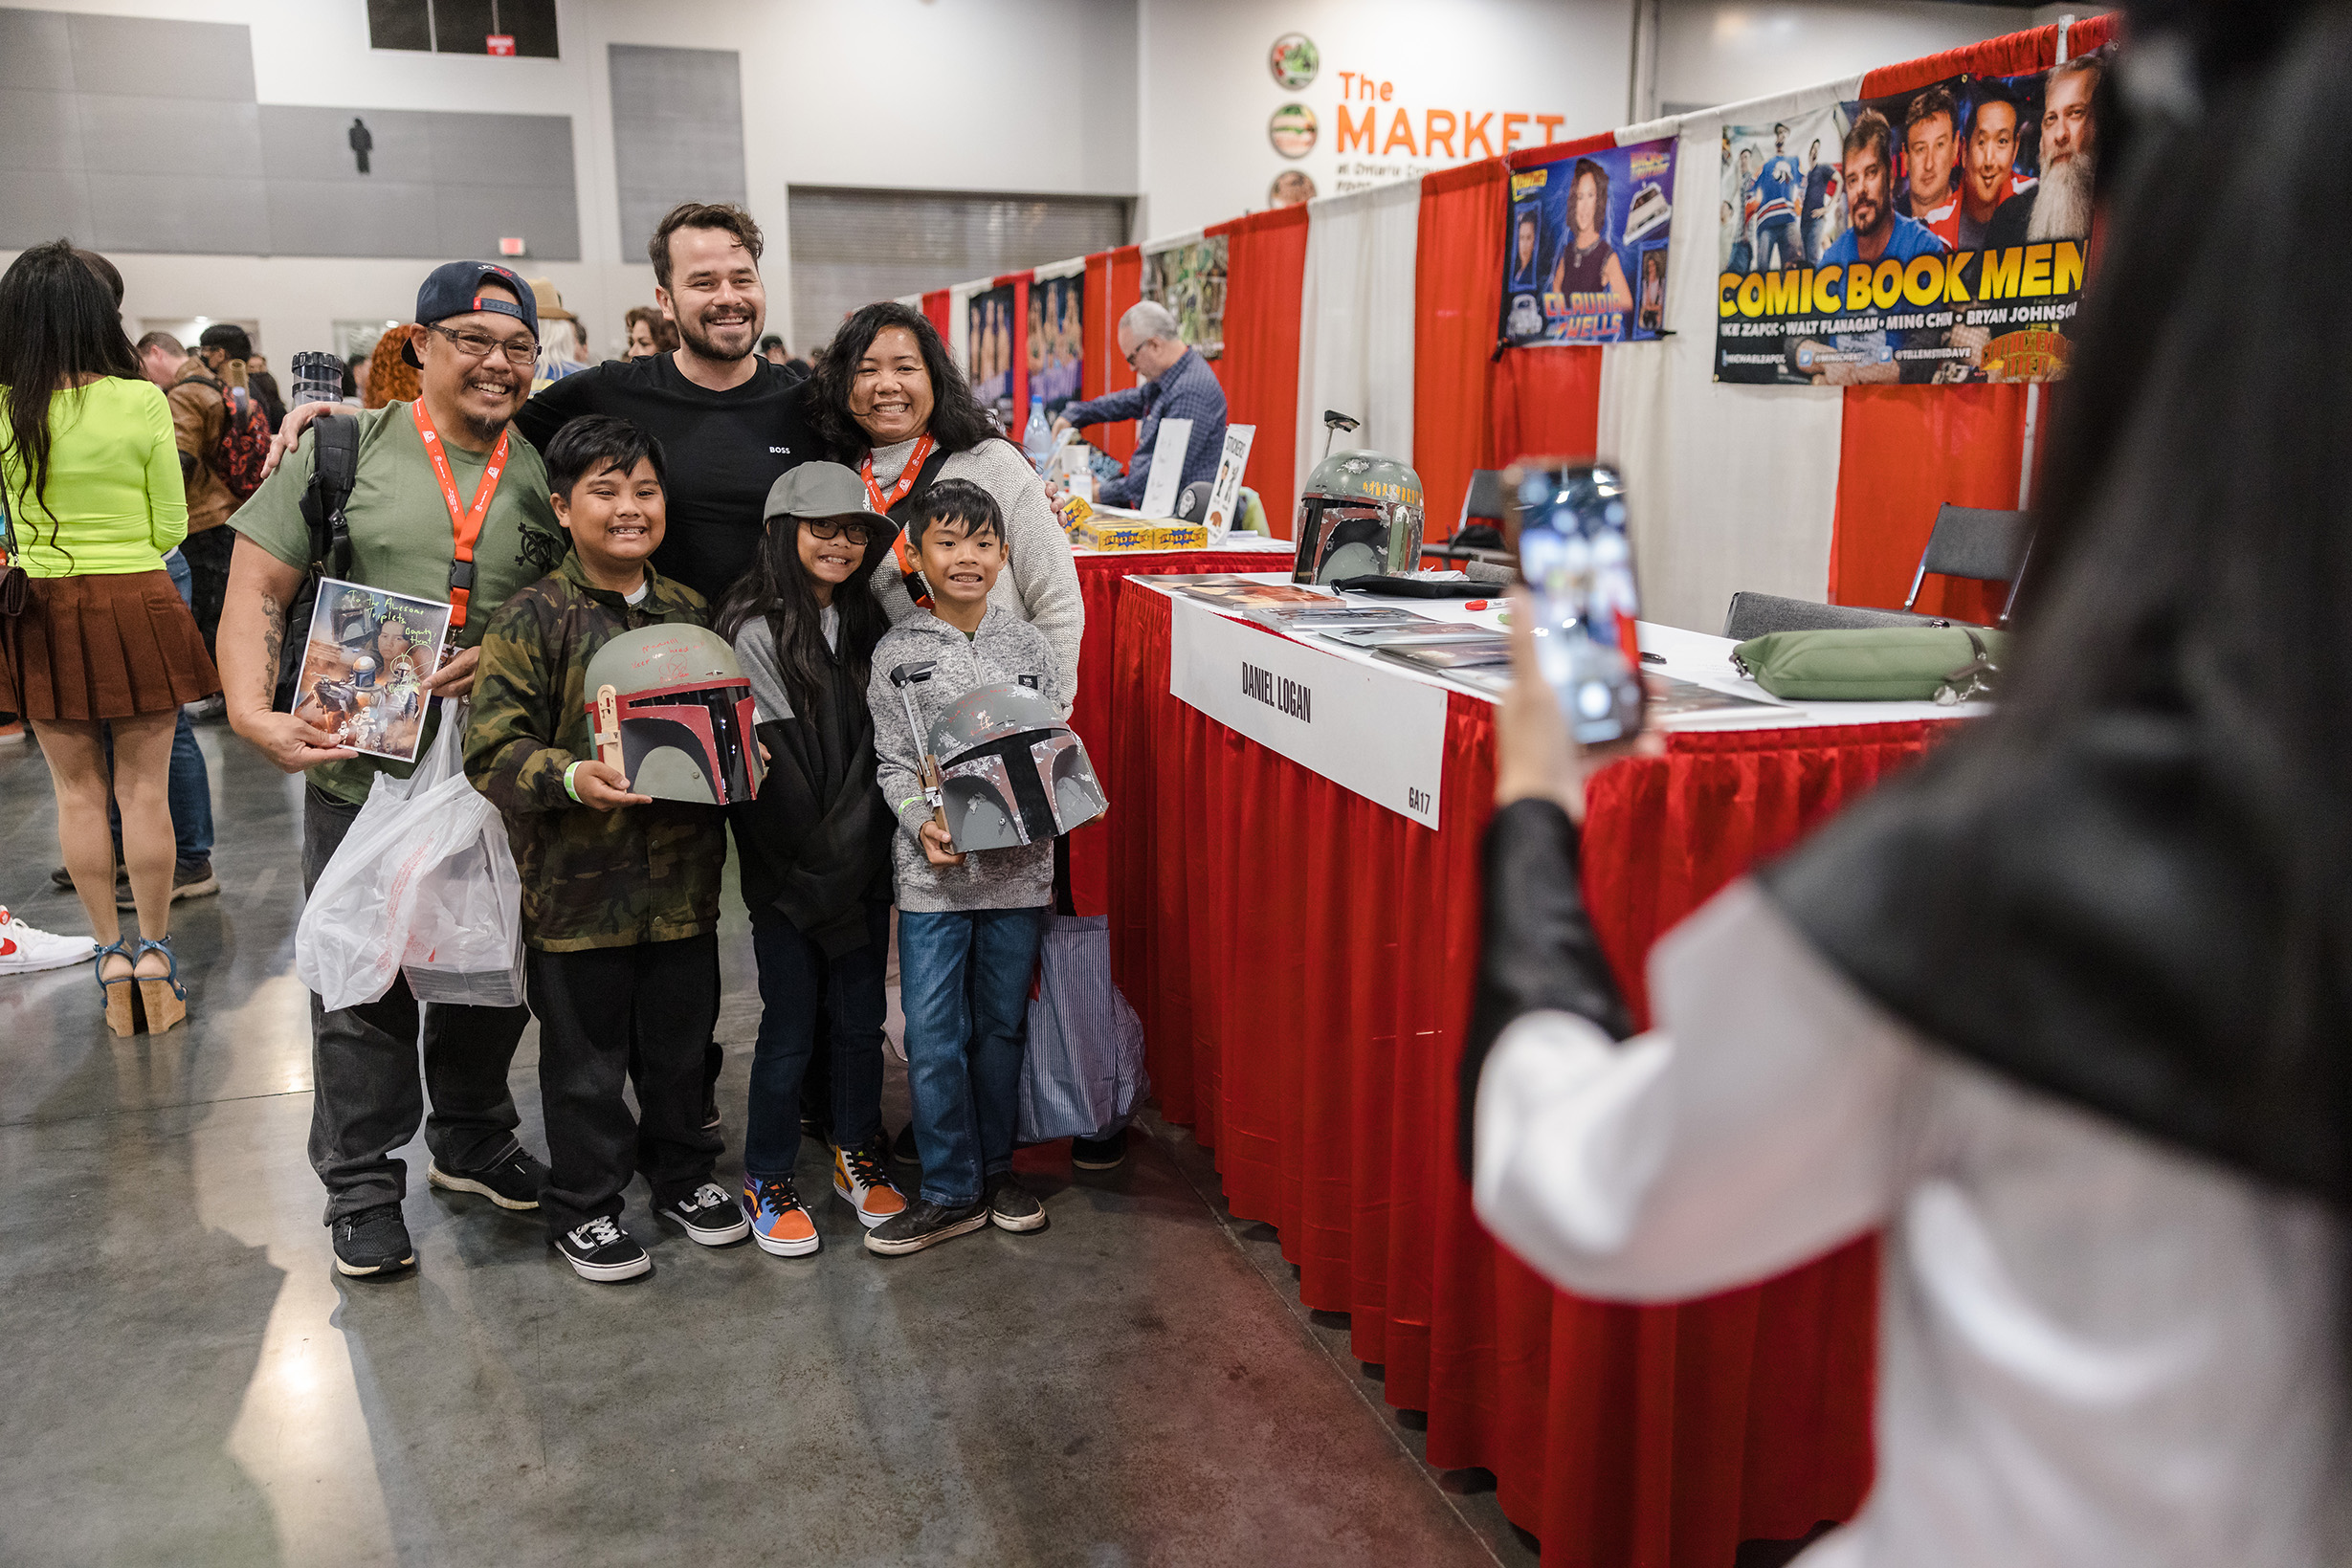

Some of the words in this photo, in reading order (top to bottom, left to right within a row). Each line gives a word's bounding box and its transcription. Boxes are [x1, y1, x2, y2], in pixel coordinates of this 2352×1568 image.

[1338, 72, 1393, 101] The
[1337, 104, 1564, 159] MARKET
[1720, 265, 1842, 318] COMIC
[1847, 252, 1975, 311] BOOK
[1979, 239, 2089, 301] MEN
[1543, 292, 1624, 316] CLAUDIA
[1566, 316, 1624, 338] WELLS
[1786, 320, 1818, 336] WALT
[1820, 317, 1878, 335] FLANAGAN
[1886, 313, 1925, 330] MING
[1966, 307, 2008, 325] BRYAN
[347, 590, 360, 608] To
[367, 593, 380, 607] the
[366, 607, 407, 624] Triplets
[1242, 661, 1275, 707] DANIEL
[1277, 675, 1311, 723] LOGAN
[1409, 786, 1431, 815] GA17
